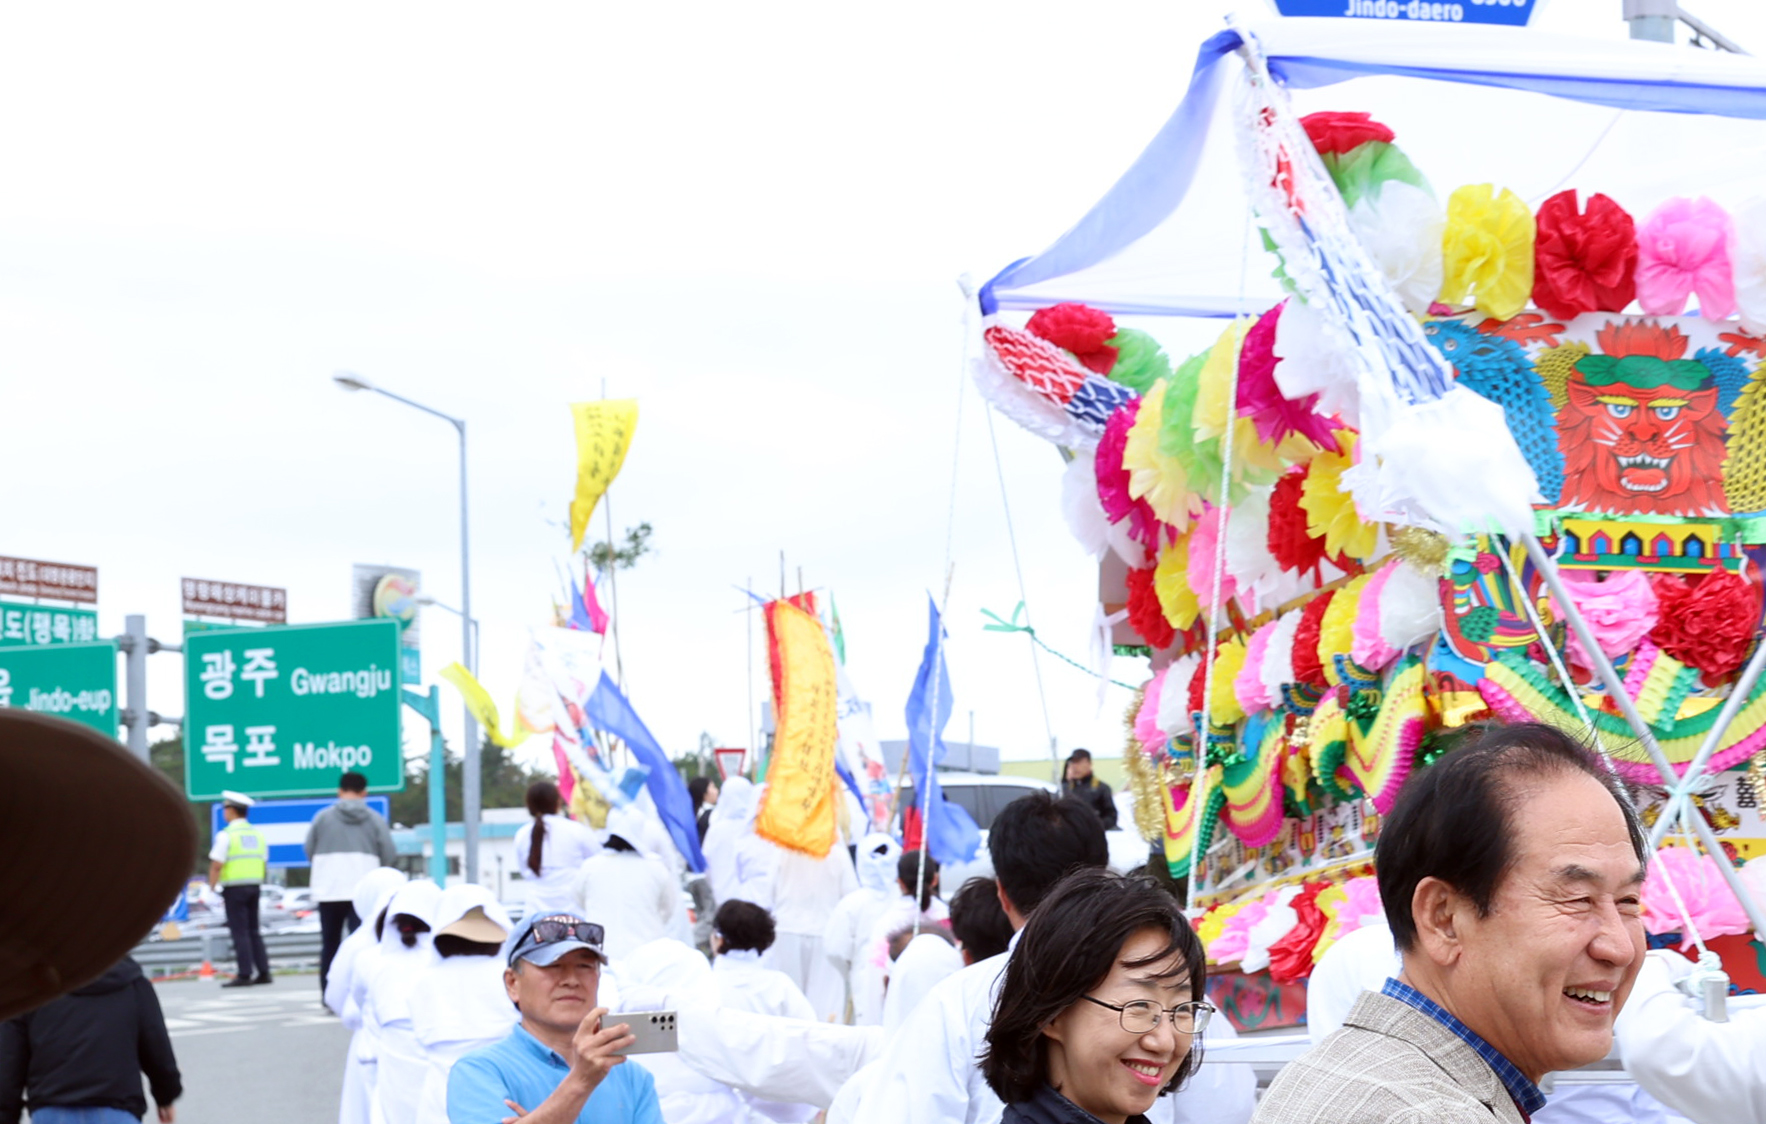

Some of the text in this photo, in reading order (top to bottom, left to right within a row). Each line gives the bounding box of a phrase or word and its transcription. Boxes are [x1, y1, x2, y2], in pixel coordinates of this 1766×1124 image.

[1345, 0, 1463, 21] Jindo-daero
[0, 607, 96, 645] 도(팽목)항
[200, 648, 279, 700] 광주
[290, 663, 392, 698] Gwangju
[23, 685, 112, 717] Jindo-eup
[201, 723, 373, 774] 목포 Mokpo
